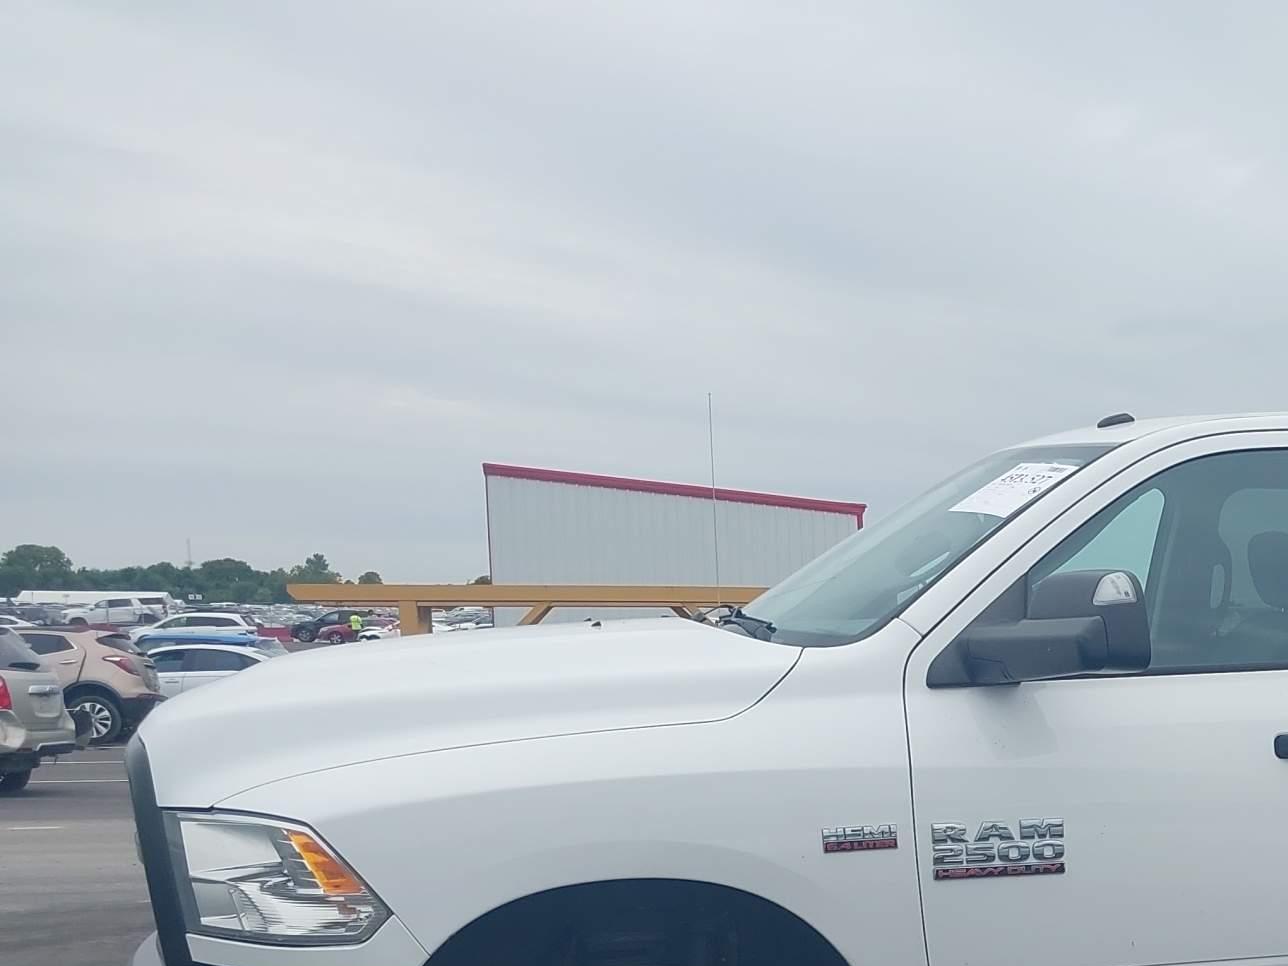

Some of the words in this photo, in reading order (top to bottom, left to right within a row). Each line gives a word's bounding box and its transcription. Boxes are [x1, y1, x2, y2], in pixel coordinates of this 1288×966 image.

[822, 824, 897, 841] HEMI
[931, 818, 1064, 844] RAM
[933, 840, 1065, 865] 2500
[938, 866, 1004, 878] HEAVY
[1007, 863, 1061, 875] DUTY
